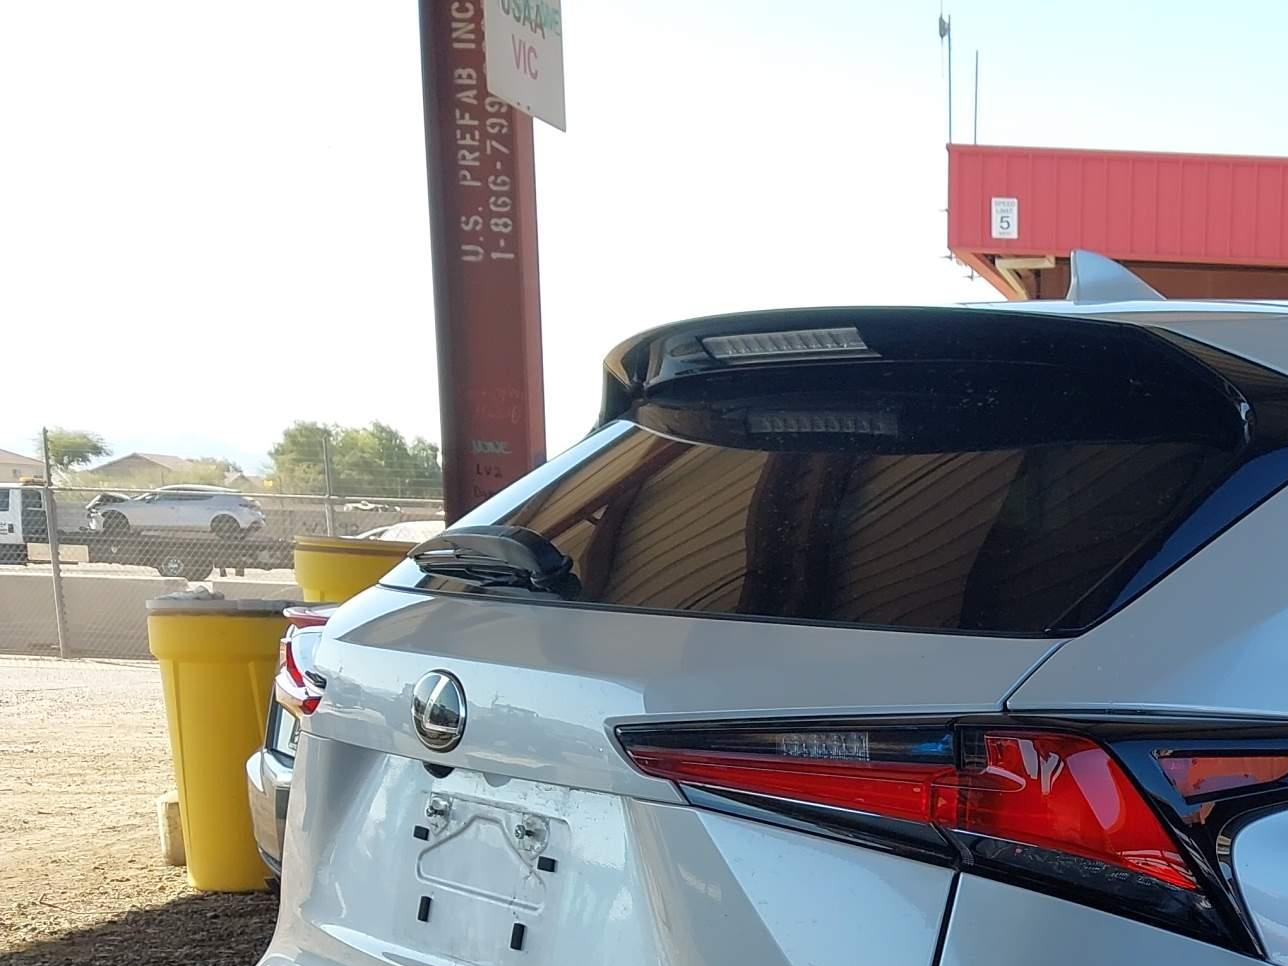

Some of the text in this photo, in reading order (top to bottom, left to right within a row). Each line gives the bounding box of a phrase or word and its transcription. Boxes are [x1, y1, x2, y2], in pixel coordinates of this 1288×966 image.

[511, 33, 539, 80] VIC
[453, 68, 481, 187] PREFAB
[461, 207, 484, 262] U.S.
[1000, 215, 1010, 230] 5
